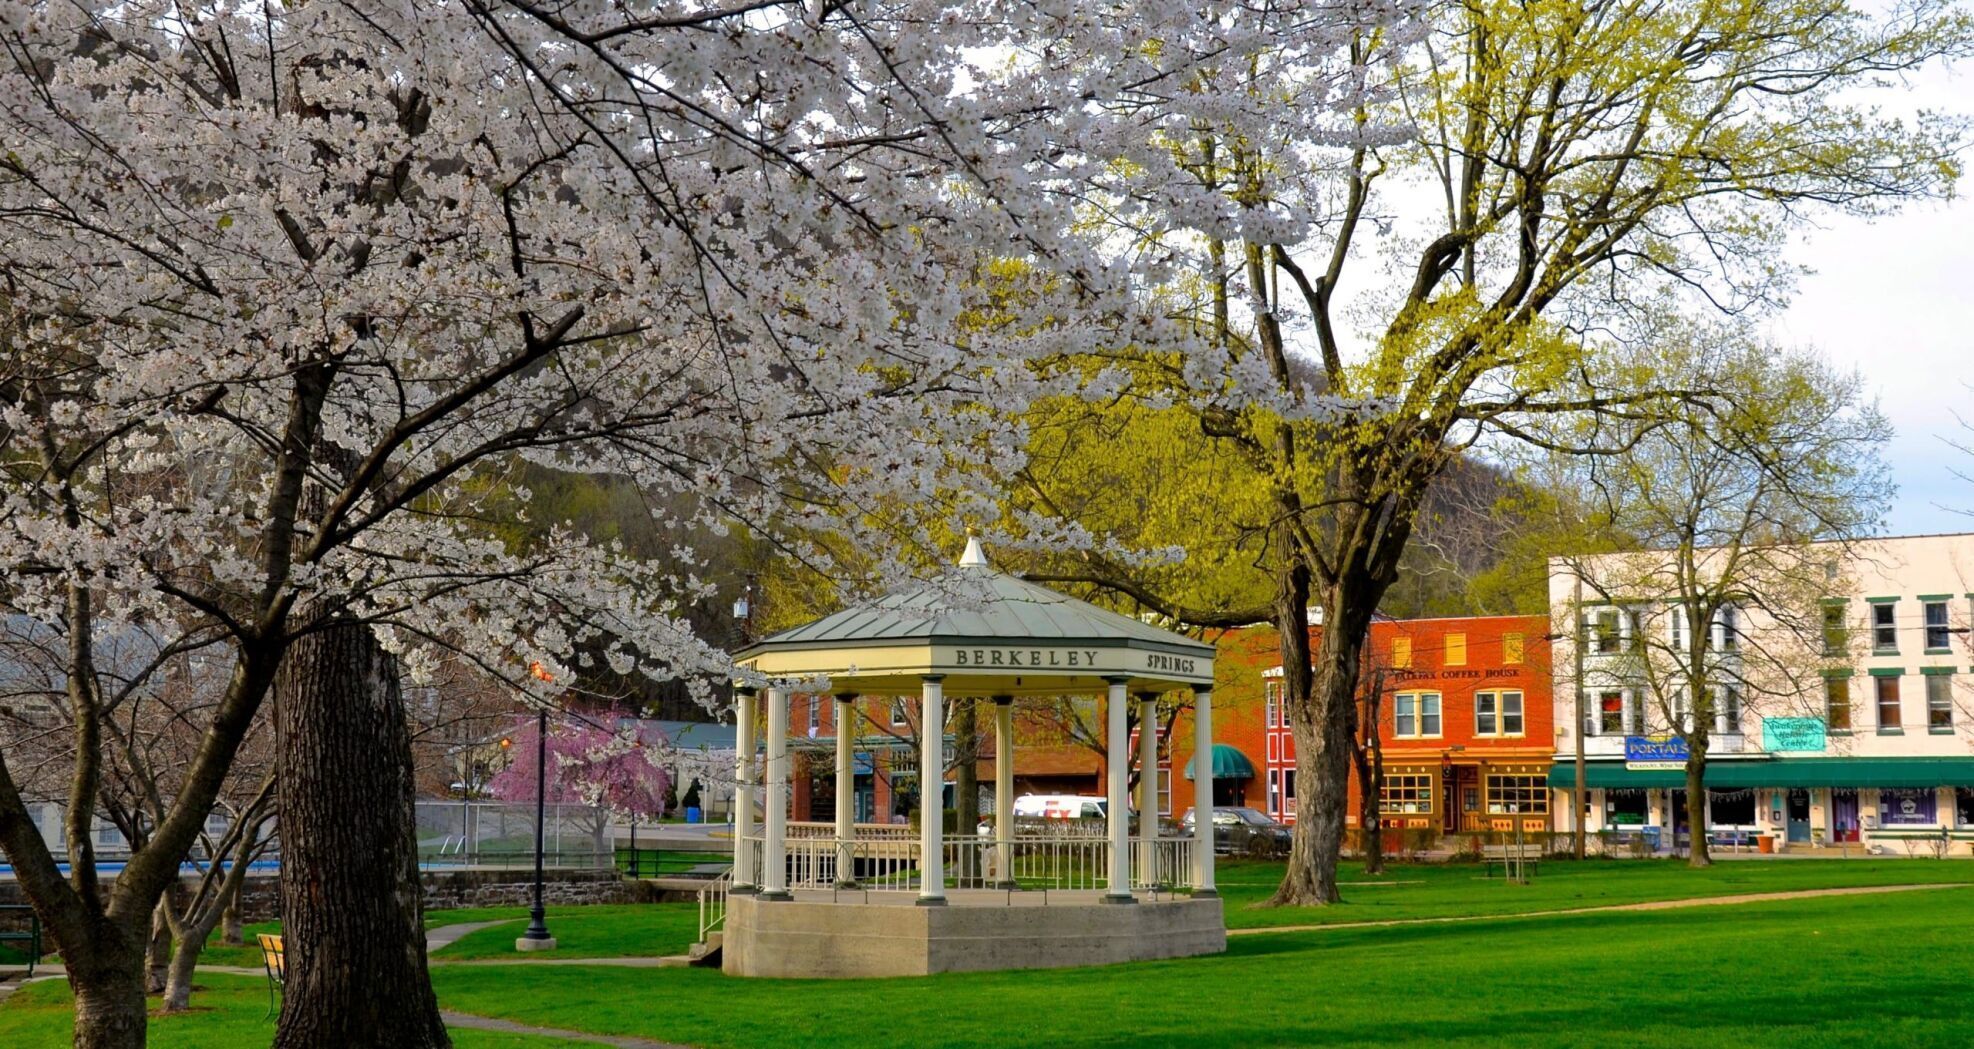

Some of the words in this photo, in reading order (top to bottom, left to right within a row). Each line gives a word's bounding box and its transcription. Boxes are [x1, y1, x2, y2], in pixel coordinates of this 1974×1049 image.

[956, 650, 1098, 666] BERKELEY
[1147, 654, 1195, 673] SPRINGS
[1441, 670, 1480, 679] COFFEE
[1485, 669, 1519, 678] HOUSE
[1629, 743, 1690, 754] PORTALS
